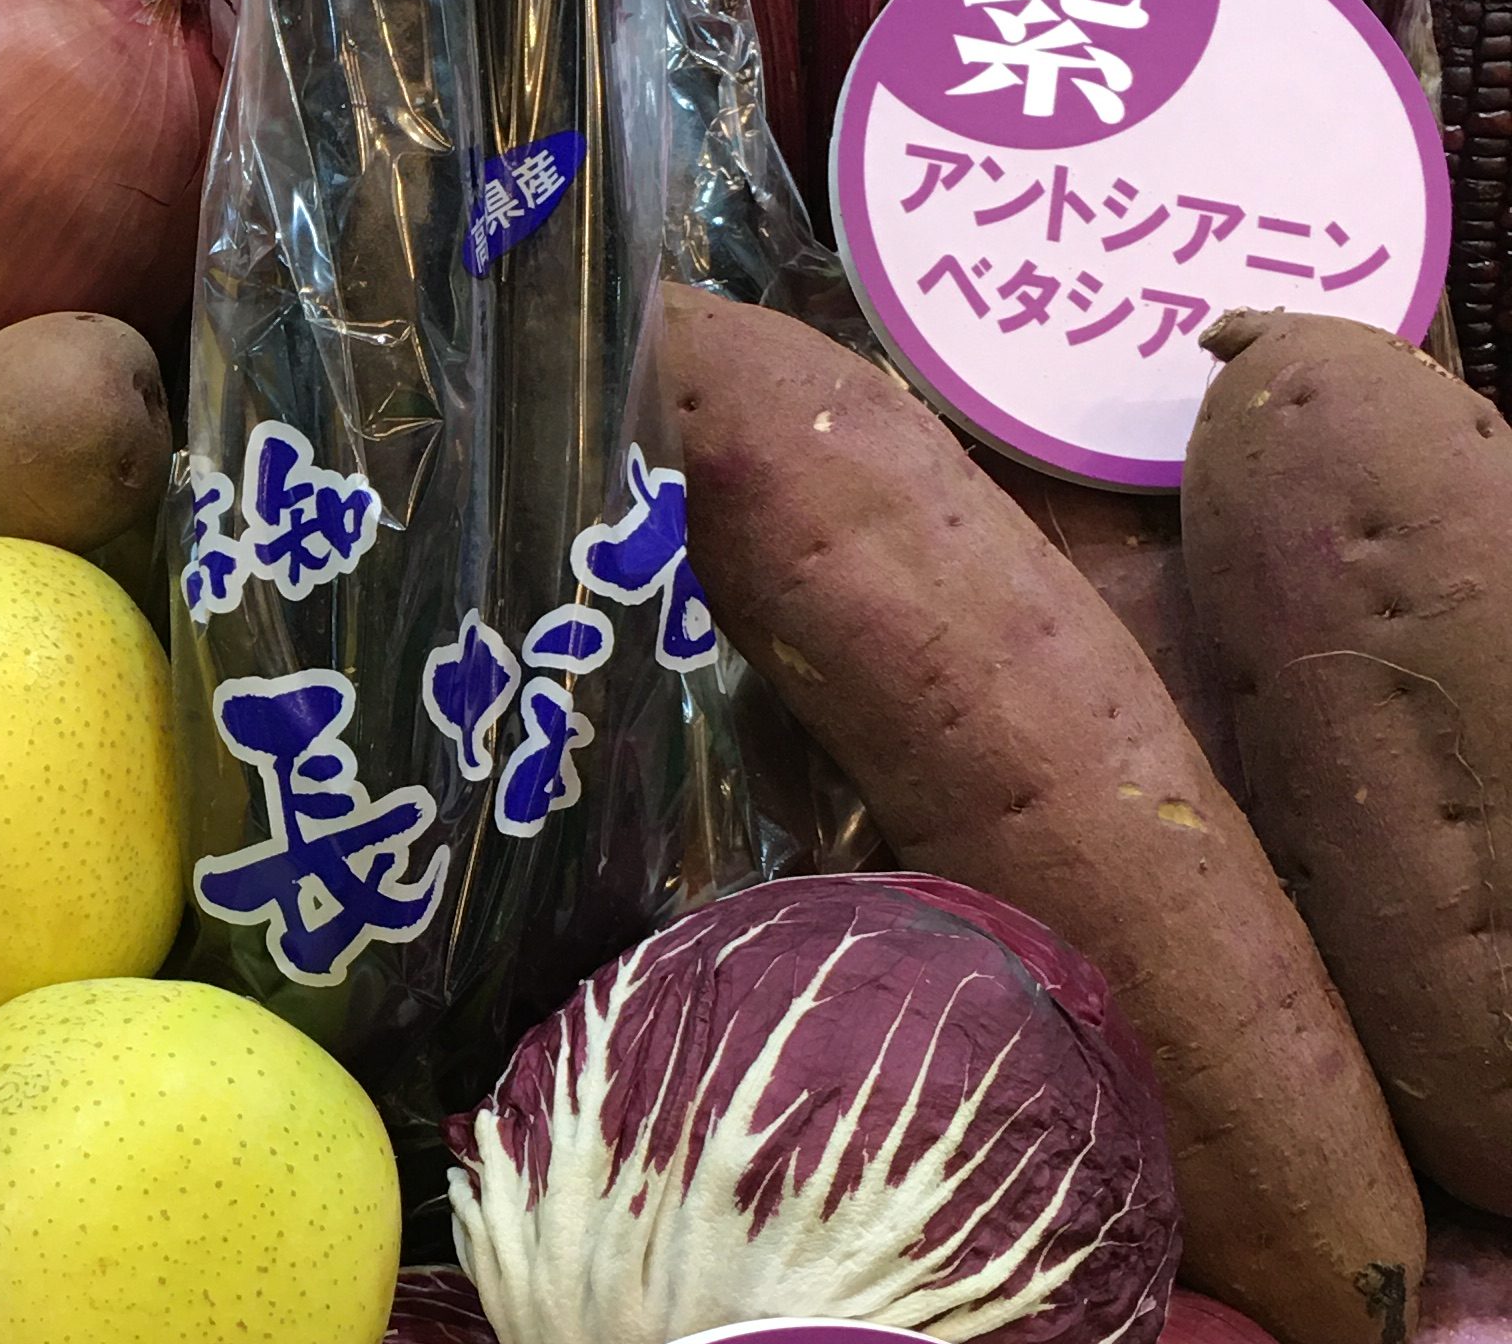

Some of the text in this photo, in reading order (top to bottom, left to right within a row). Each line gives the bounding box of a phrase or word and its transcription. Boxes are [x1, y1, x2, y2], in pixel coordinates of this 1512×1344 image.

[899, 143, 1391, 292] アントシアニン
[917, 253, 1212, 359] ベタシア
